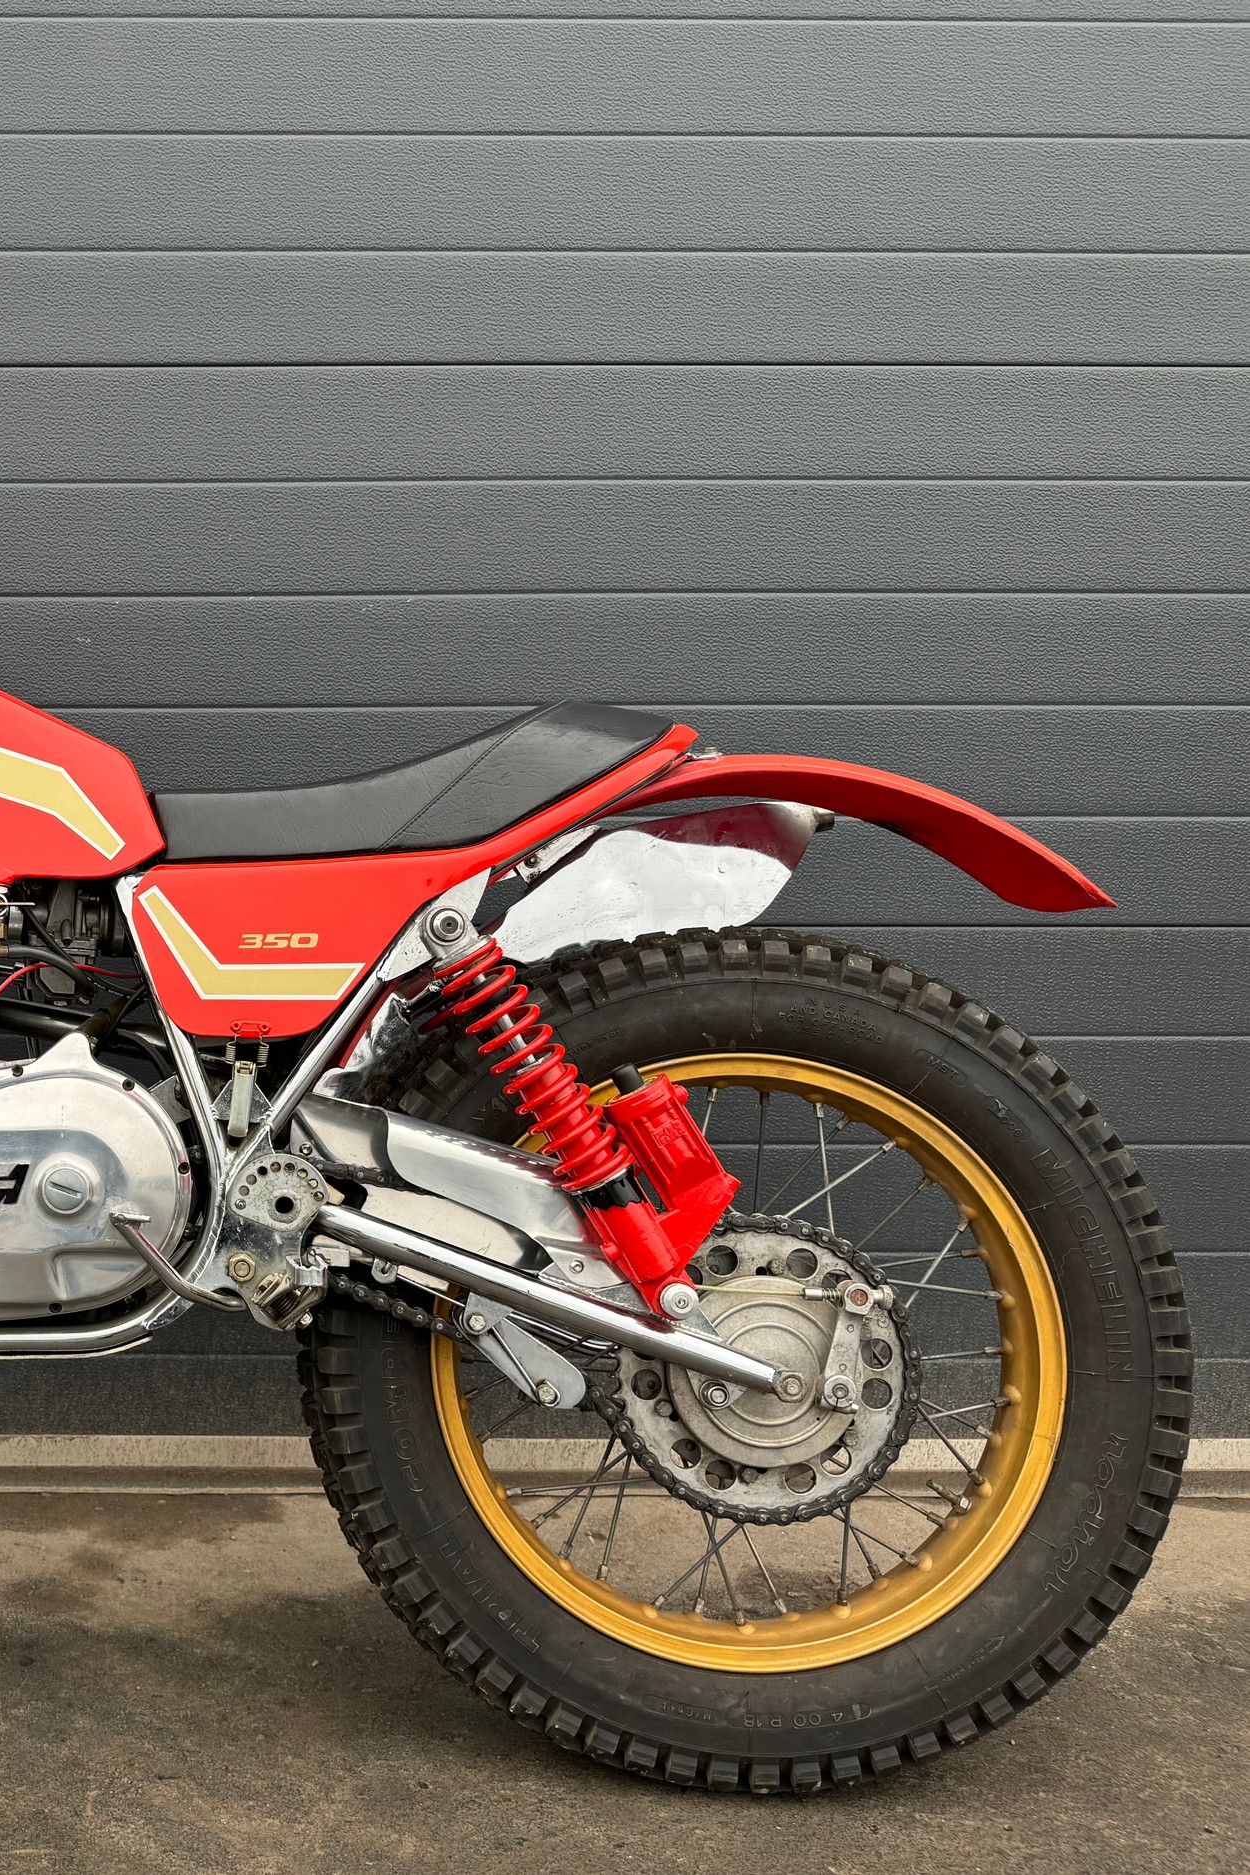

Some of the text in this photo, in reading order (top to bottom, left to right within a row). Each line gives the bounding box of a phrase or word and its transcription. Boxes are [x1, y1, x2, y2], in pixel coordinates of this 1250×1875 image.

[238, 932, 319, 949] 350
[789, 1002, 879, 1032] AND CANADA
[924, 1054, 959, 1081] MST
[1030, 1149, 1133, 1593] MICHELIN radial
[381, 1315, 540, 1654] TRIAL COMPE
